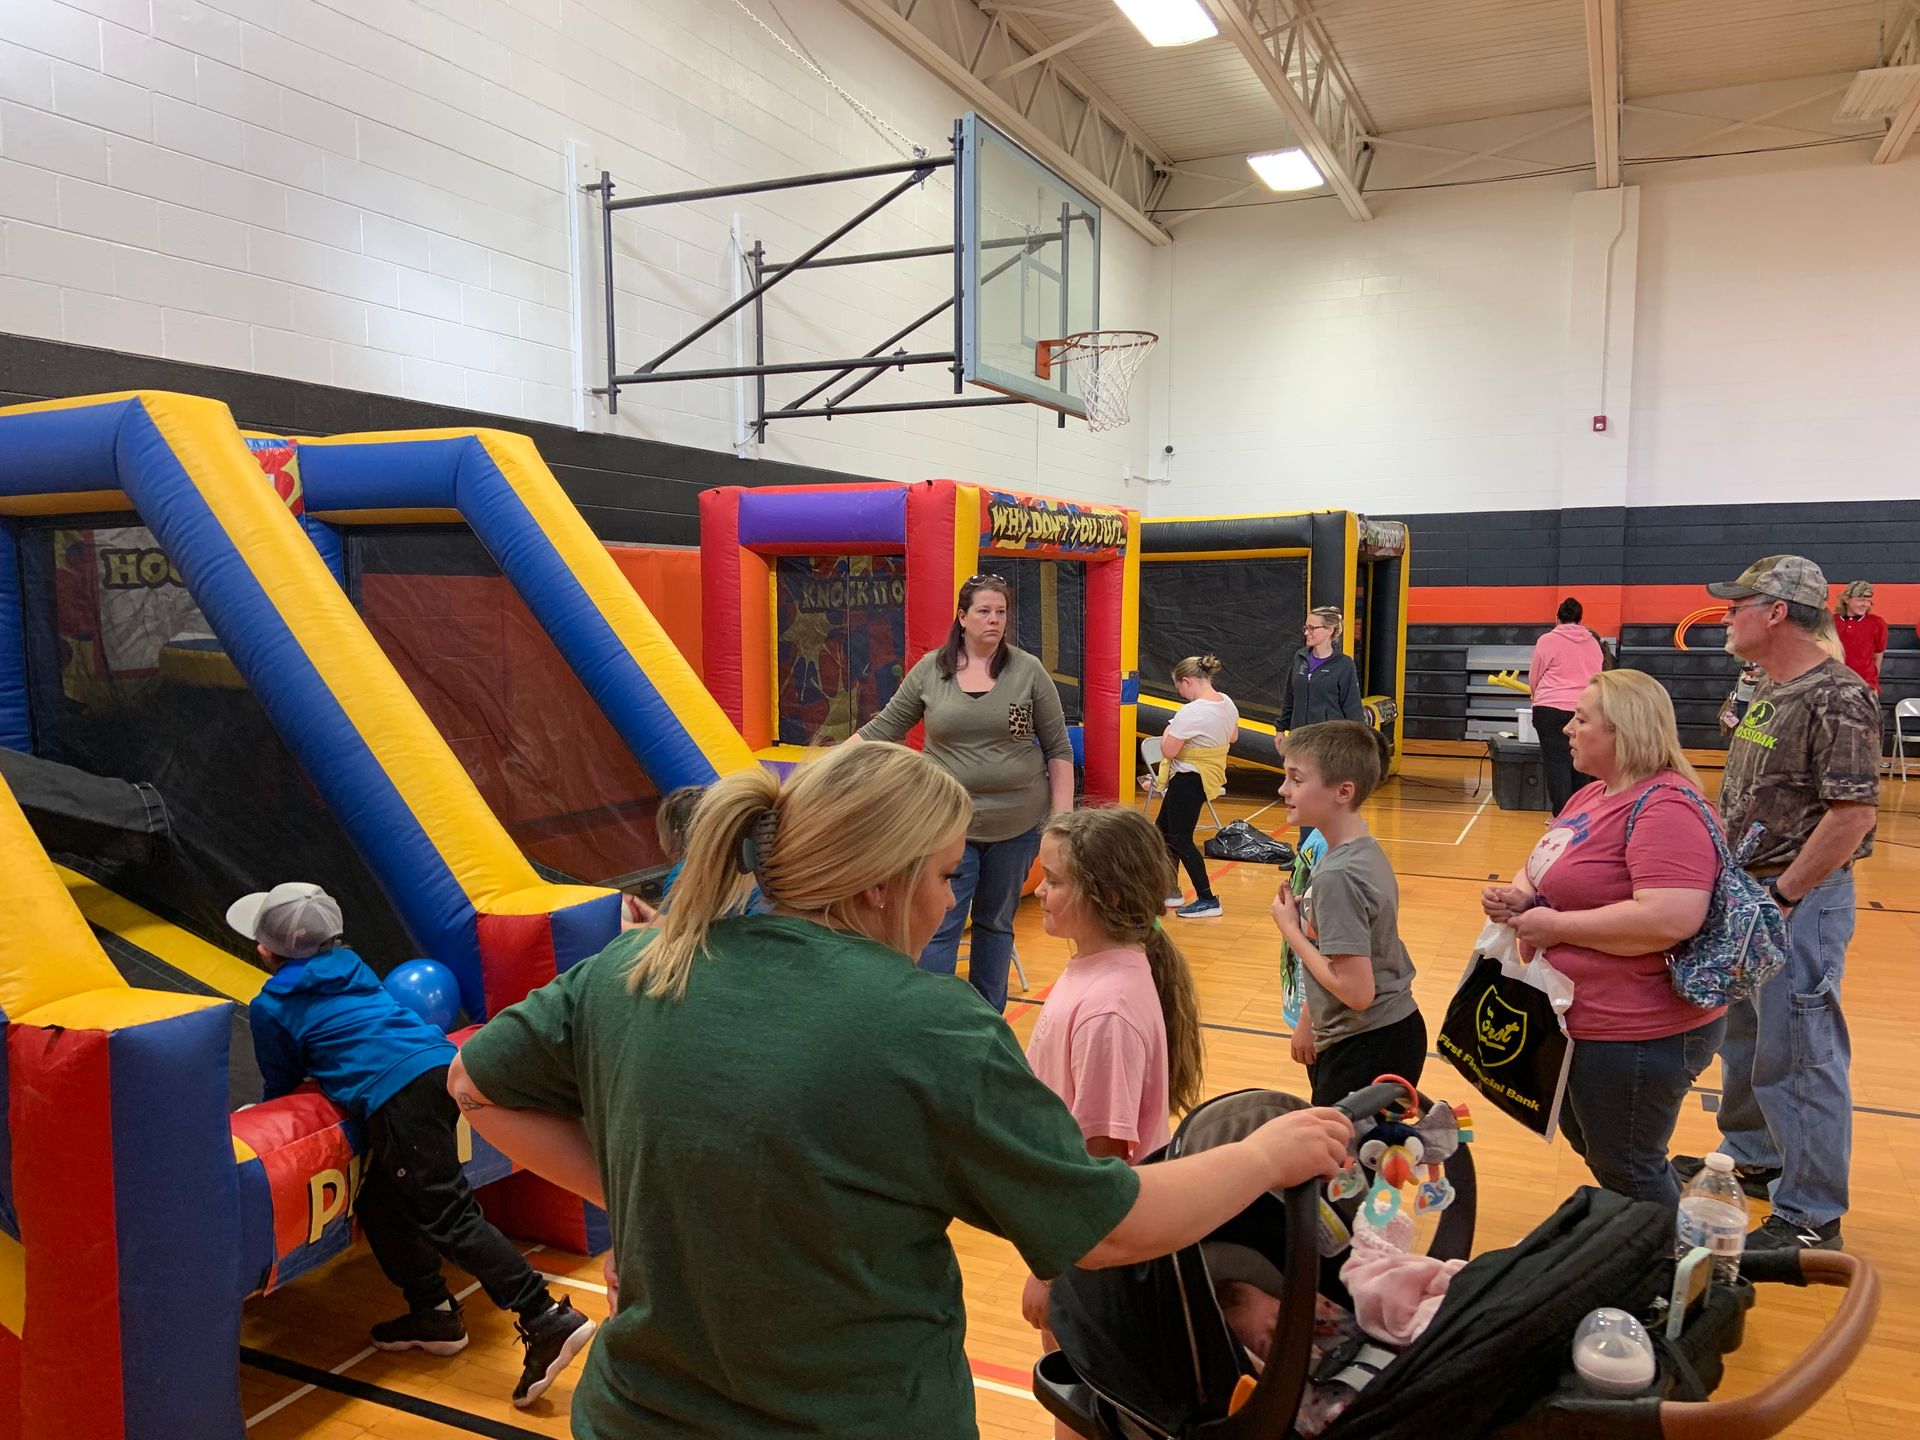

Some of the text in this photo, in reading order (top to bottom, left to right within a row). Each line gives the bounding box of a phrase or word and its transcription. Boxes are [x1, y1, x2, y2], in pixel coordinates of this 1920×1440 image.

[991, 505, 1029, 538] WHY
[1070, 515, 1097, 544] YOU
[106, 552, 184, 586] HO
[801, 581, 869, 608] KNOCK
[891, 579, 905, 604] O
[1439, 1033, 1463, 1057] First
[1506, 1087, 1540, 1112] Bank
